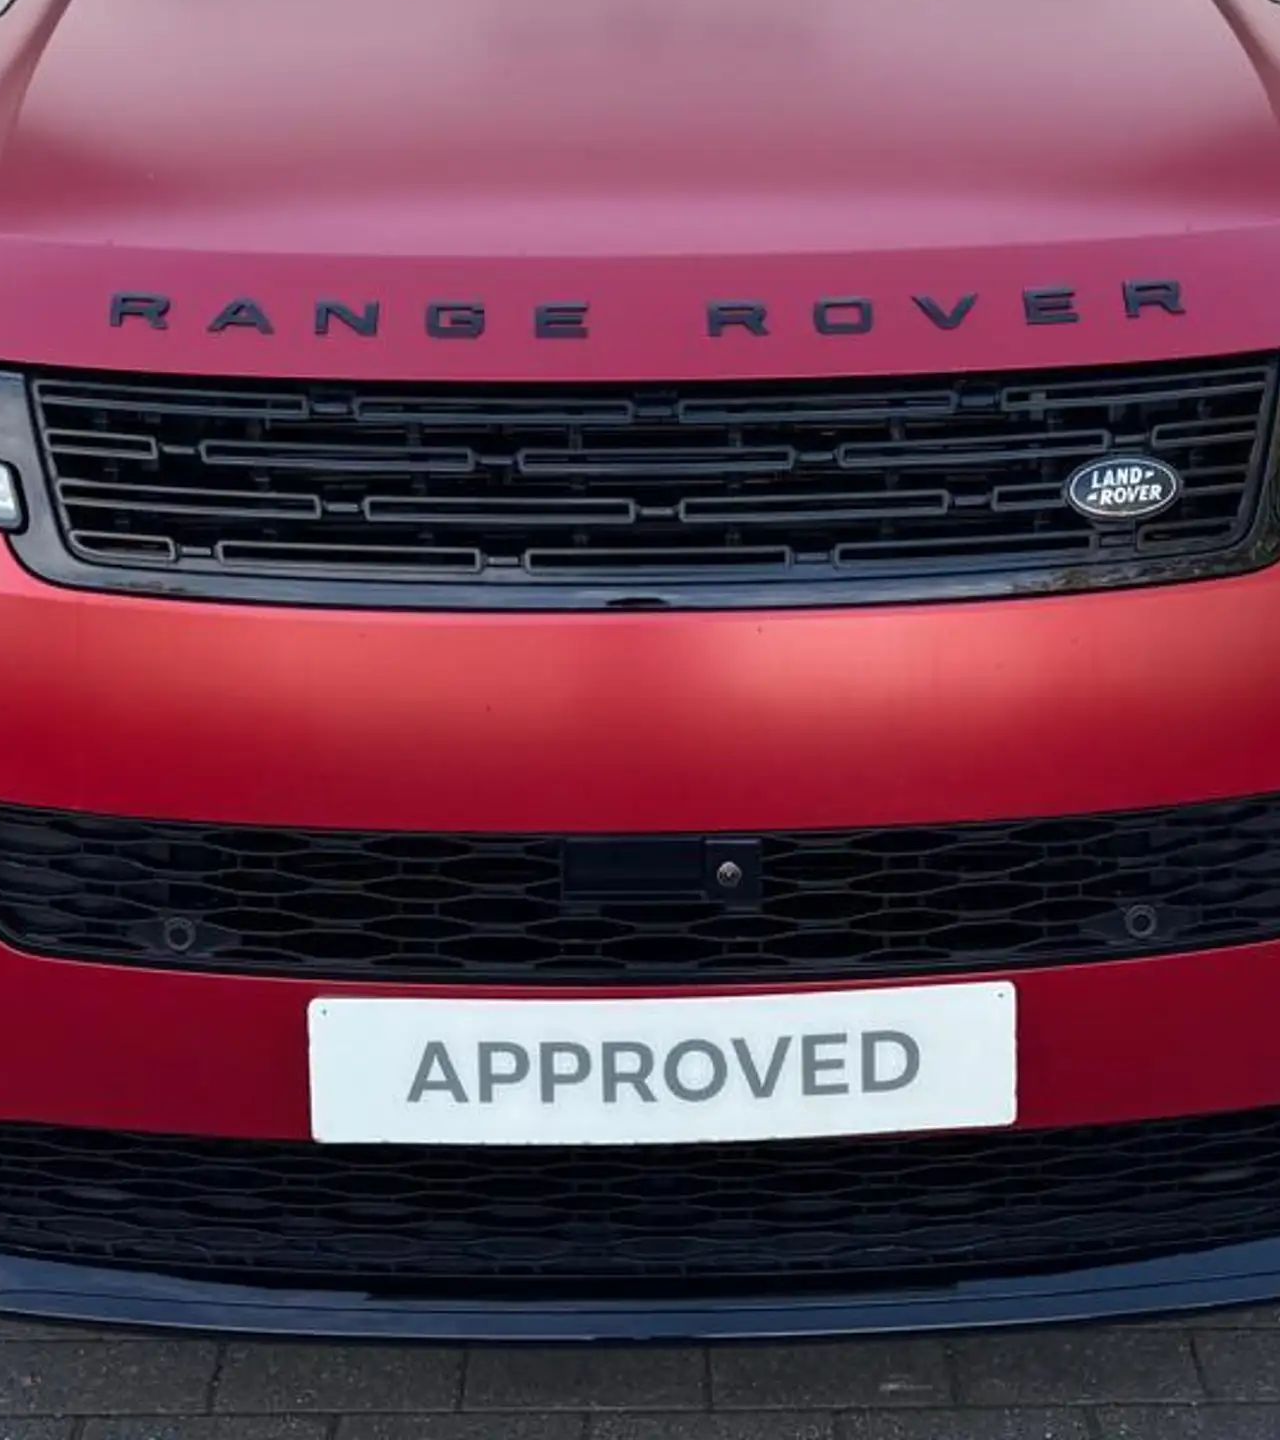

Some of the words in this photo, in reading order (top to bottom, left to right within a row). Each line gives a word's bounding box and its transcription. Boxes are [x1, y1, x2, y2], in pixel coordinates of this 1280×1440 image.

[109, 293, 589, 338] RANGE
[706, 280, 1185, 336] ROVER
[407, 1029, 921, 1105] APPROVED
